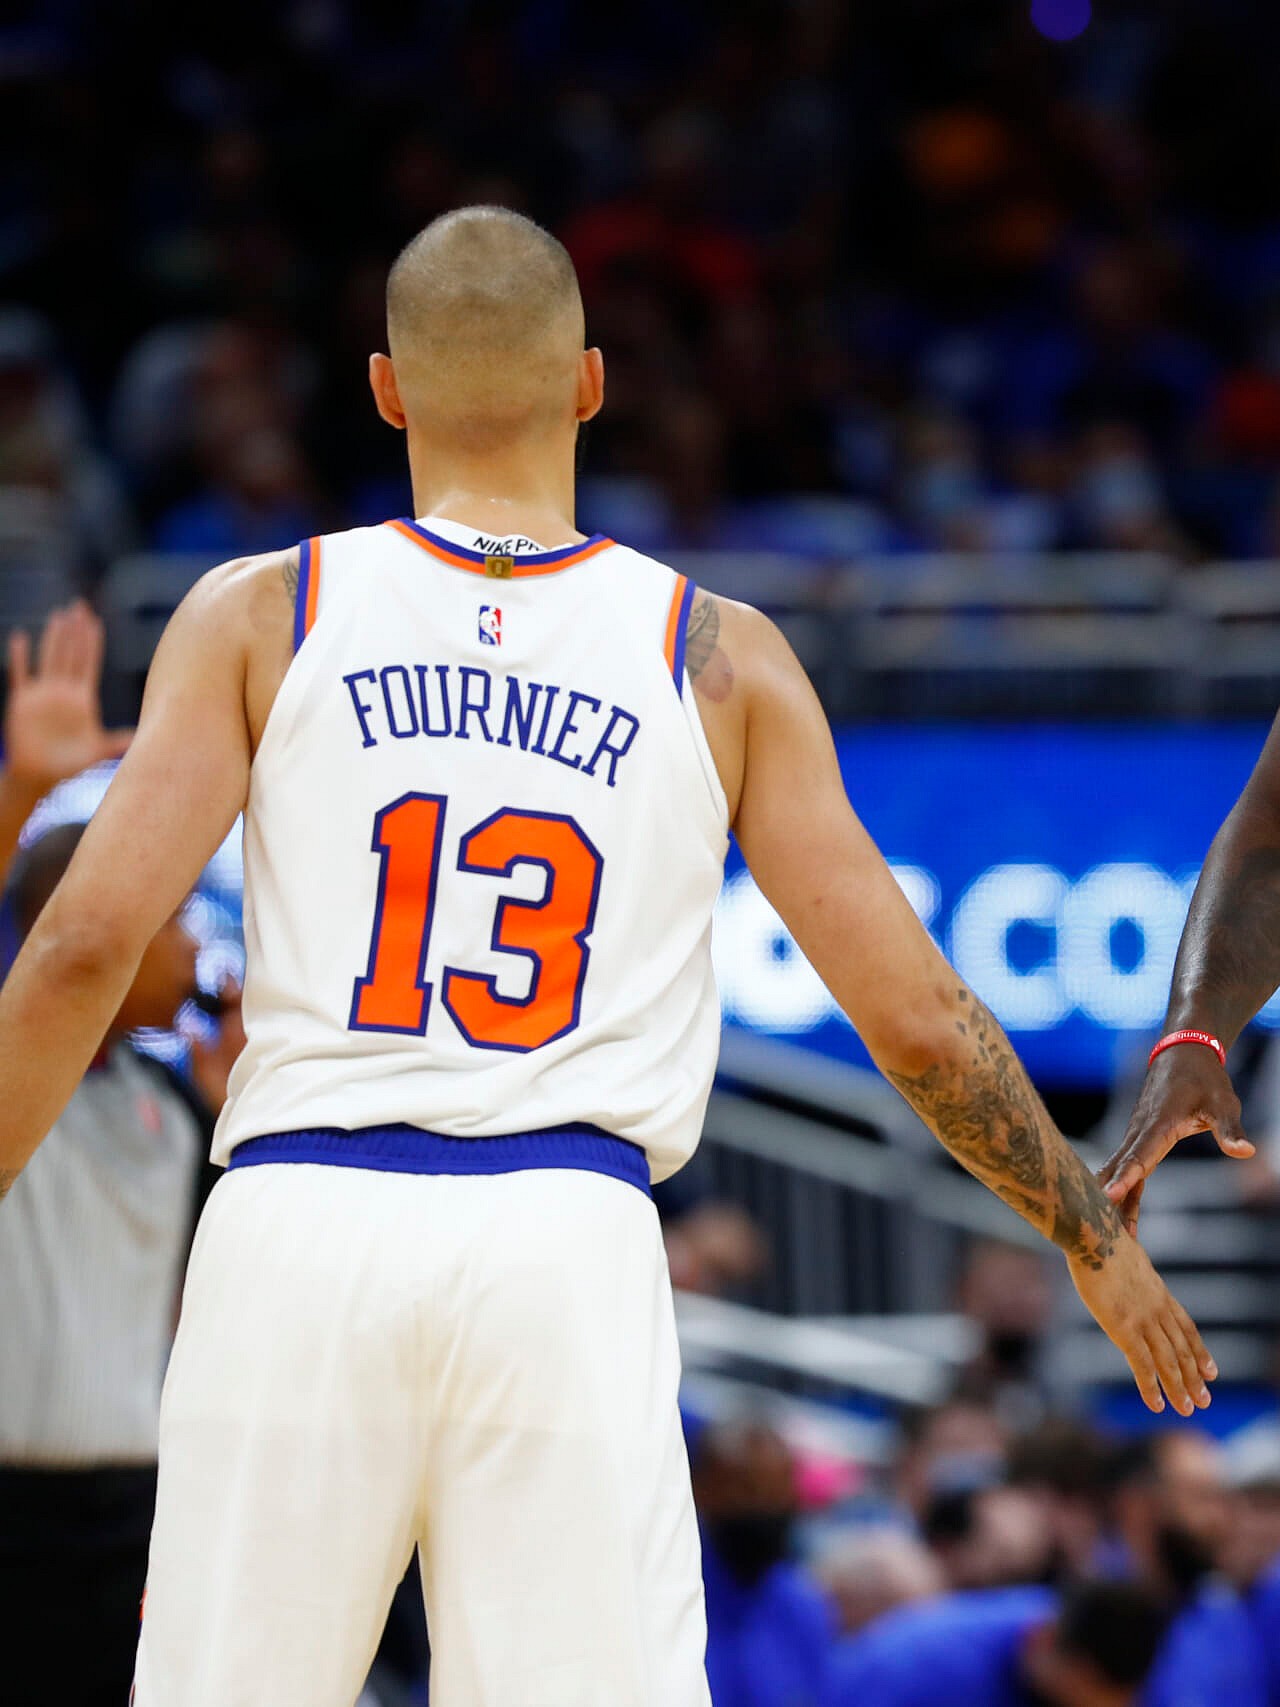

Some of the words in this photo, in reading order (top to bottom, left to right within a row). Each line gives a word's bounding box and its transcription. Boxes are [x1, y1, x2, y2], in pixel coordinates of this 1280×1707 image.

[473, 536, 513, 556] NIKE
[343, 664, 641, 788] FOURNIER
[347, 790, 605, 1054] 13
